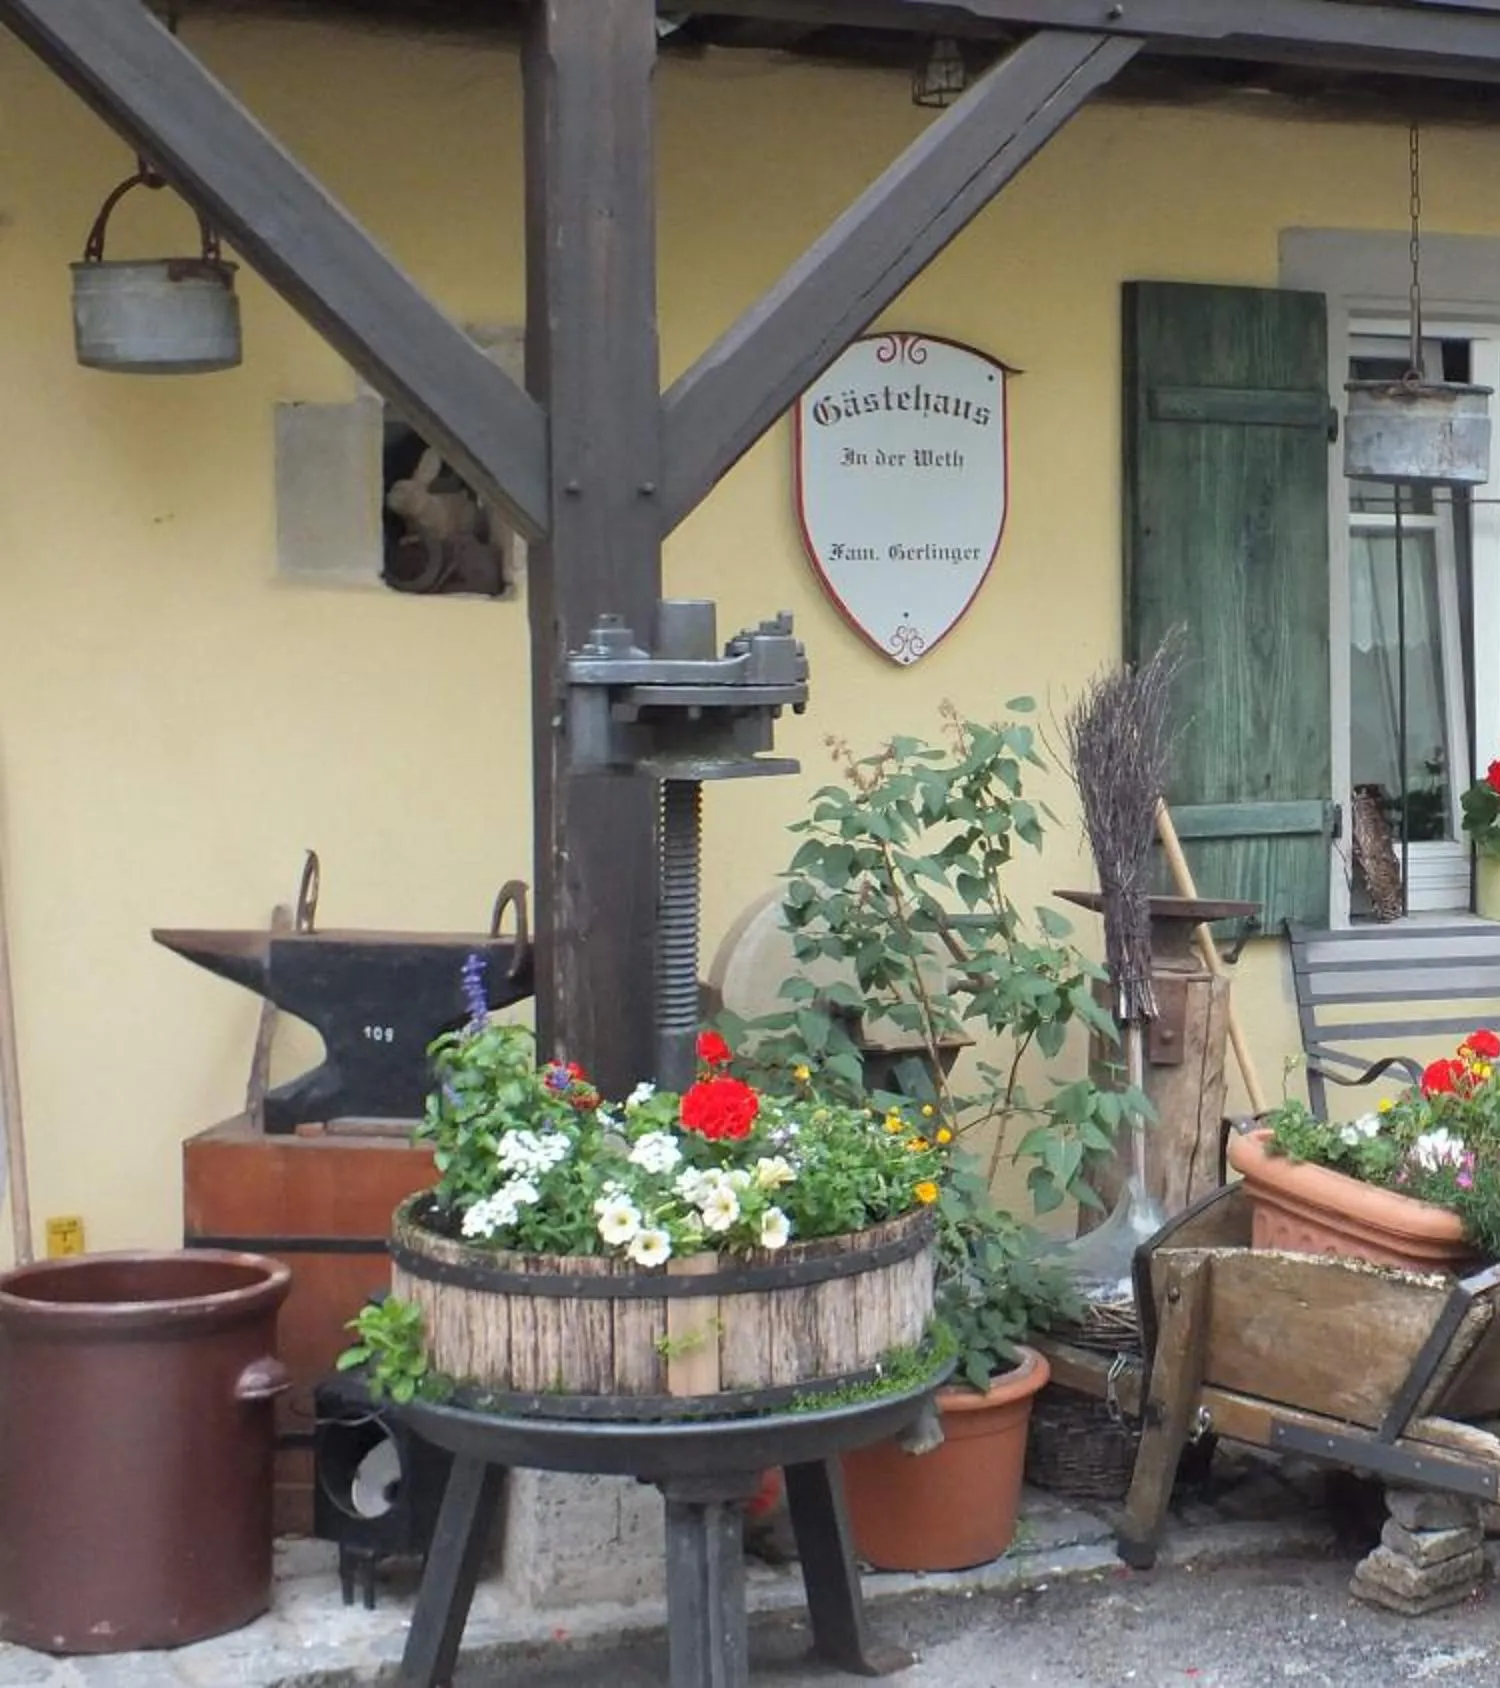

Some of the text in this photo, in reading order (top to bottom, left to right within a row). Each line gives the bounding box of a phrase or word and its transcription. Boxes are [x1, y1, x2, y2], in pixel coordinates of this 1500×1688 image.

[813, 384, 991, 427] Gästehaus
[841, 447, 964, 471] In der Weth
[828, 543, 981, 565] Fam. Gerlinger
[363, 1025, 394, 1043] 109
